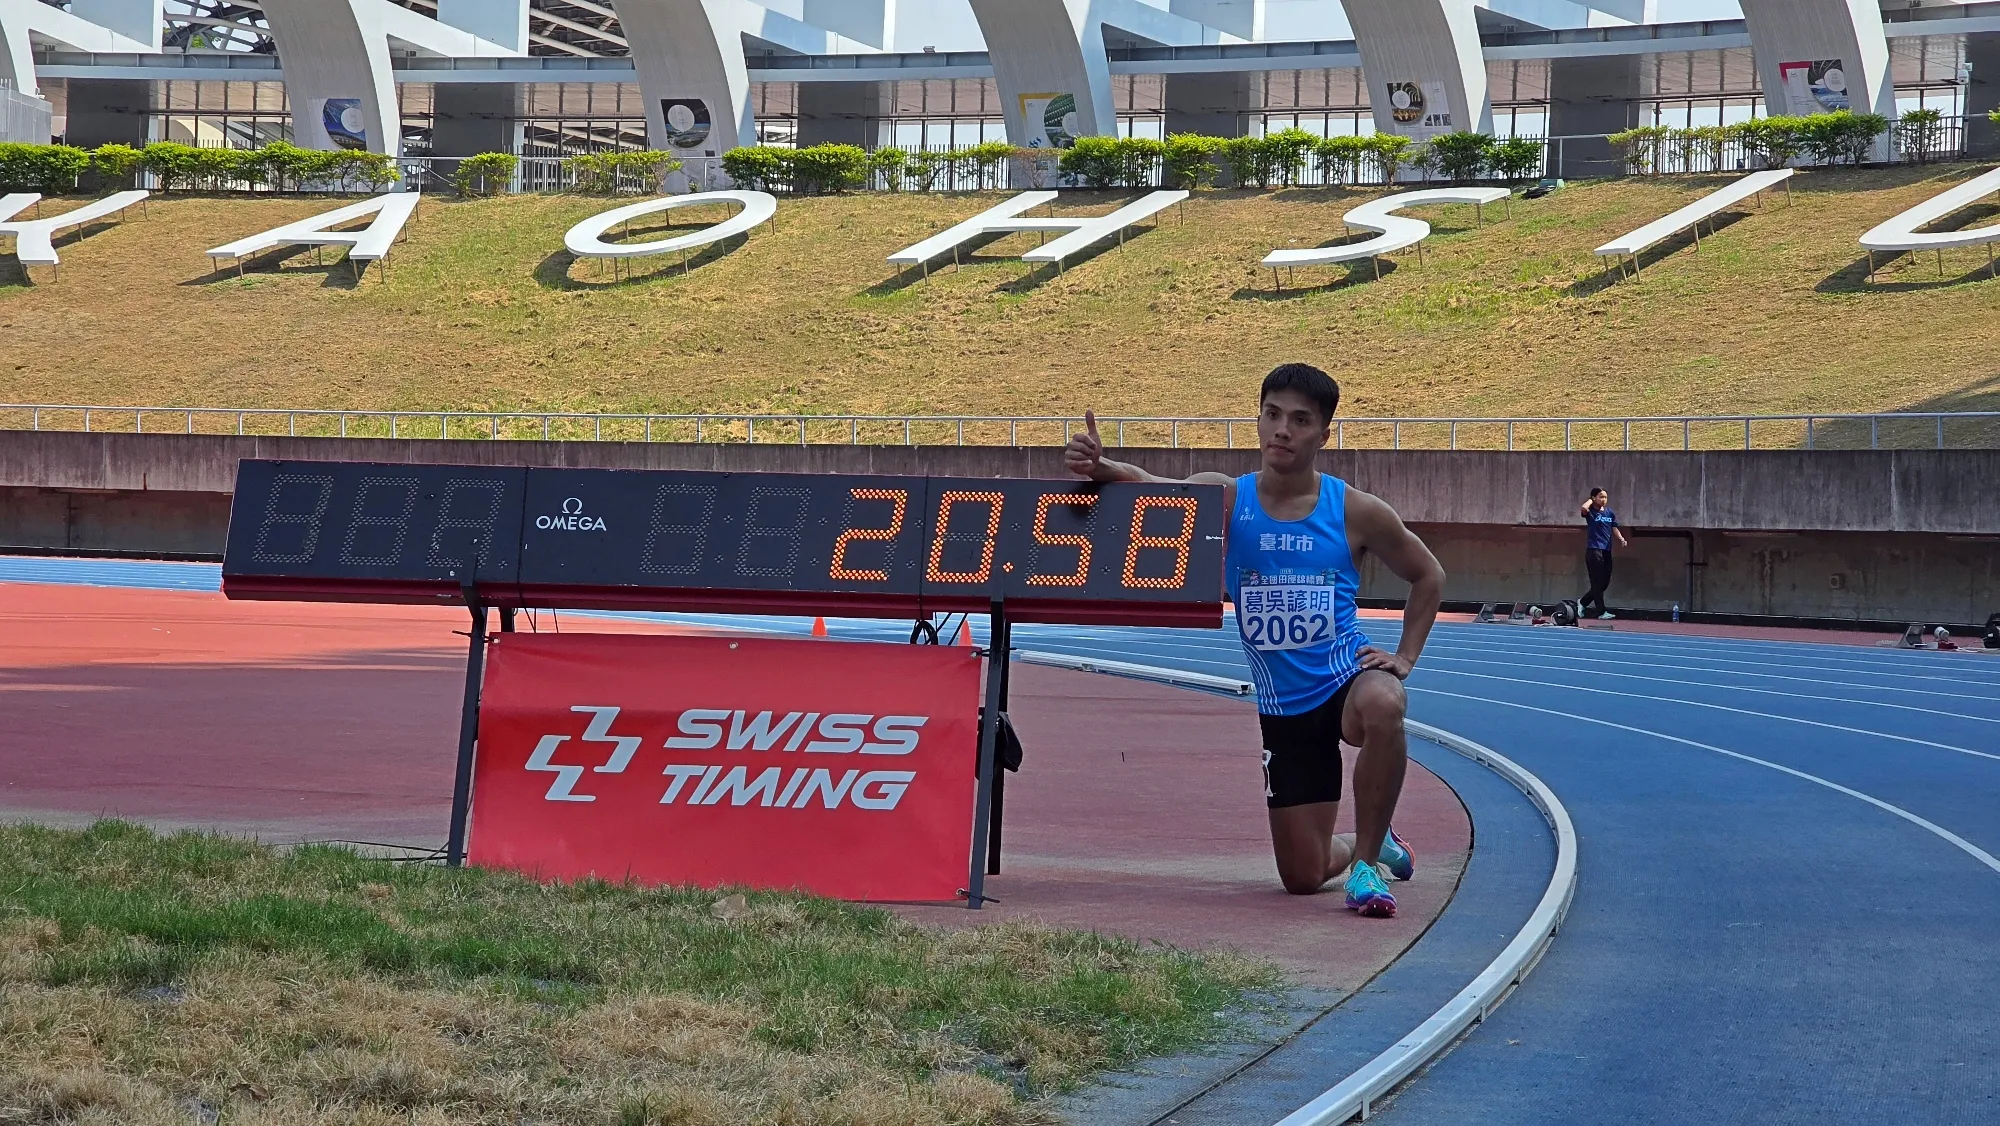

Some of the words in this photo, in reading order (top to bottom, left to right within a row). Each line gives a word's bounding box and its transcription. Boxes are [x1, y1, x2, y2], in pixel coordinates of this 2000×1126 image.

[536, 515, 607, 531] OMEGA
[829, 487, 1199, 589] 20.58
[1259, 533, 1314, 552] 臺北市
[1244, 589, 1331, 614] 葛吳諺明
[1247, 613, 1331, 646] 2062
[663, 708, 930, 756] SWISS
[659, 764, 917, 811] TIMING
